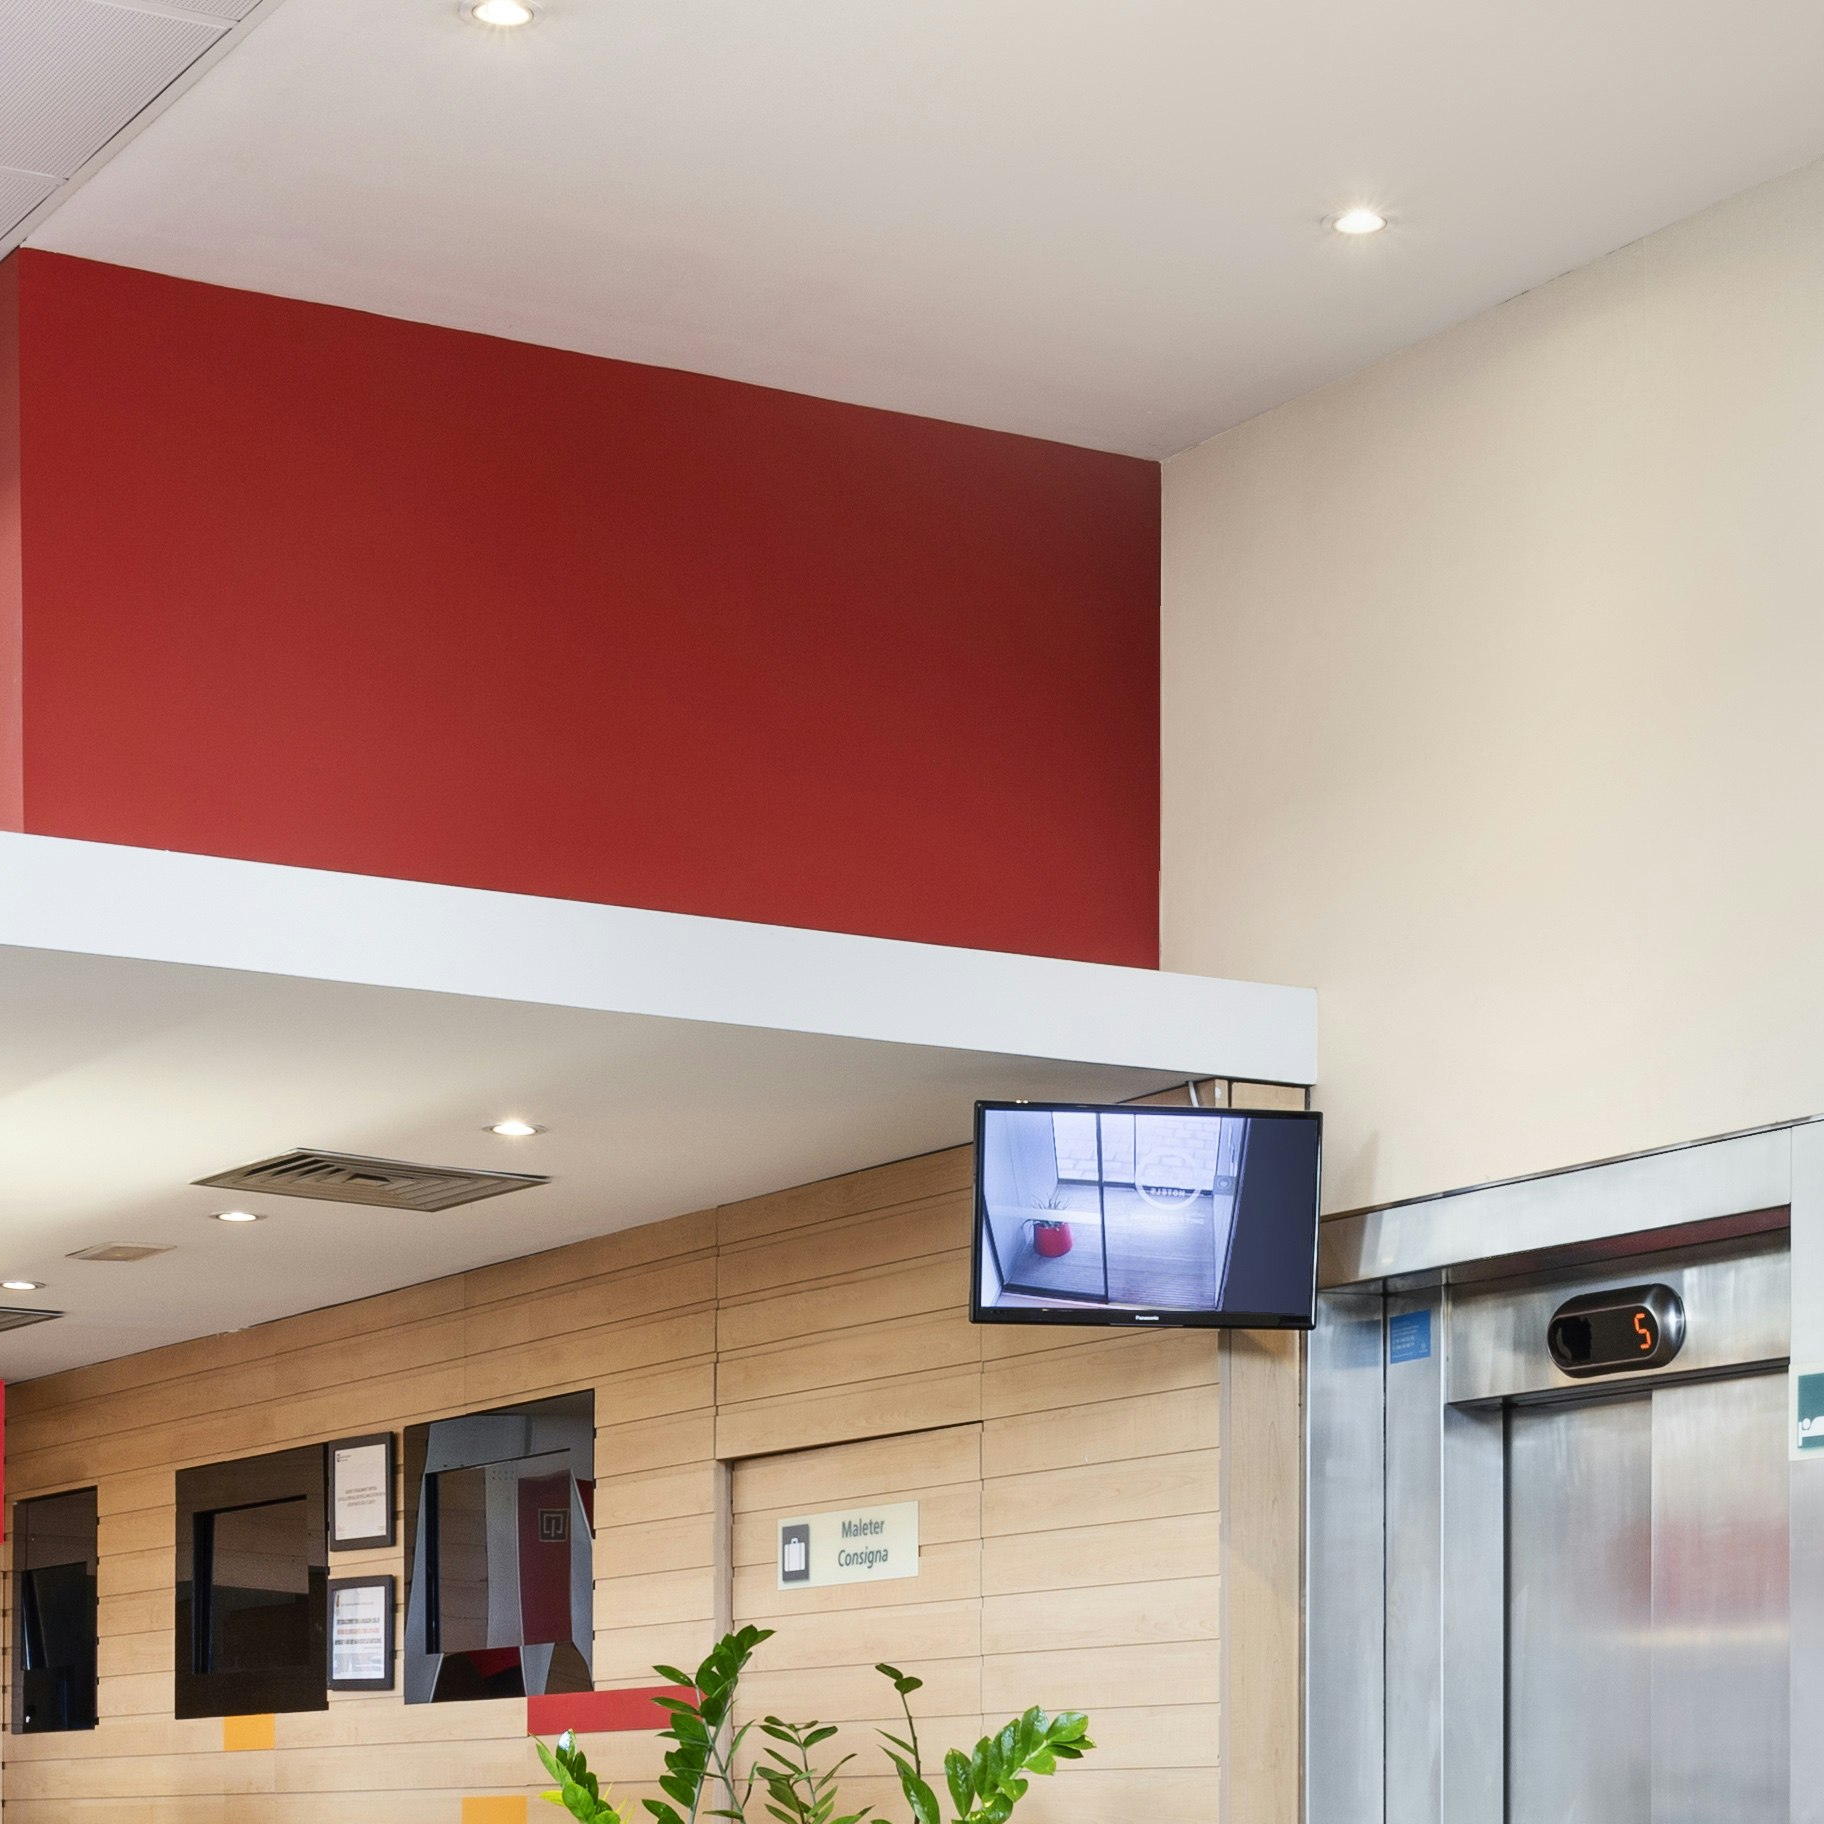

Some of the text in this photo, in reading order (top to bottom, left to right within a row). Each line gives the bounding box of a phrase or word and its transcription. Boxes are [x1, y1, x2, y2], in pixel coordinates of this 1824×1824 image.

[1633, 1312, 1652, 1350] 5
[841, 1518, 886, 1538] Maleter
[837, 1545, 889, 1569] Consigna
